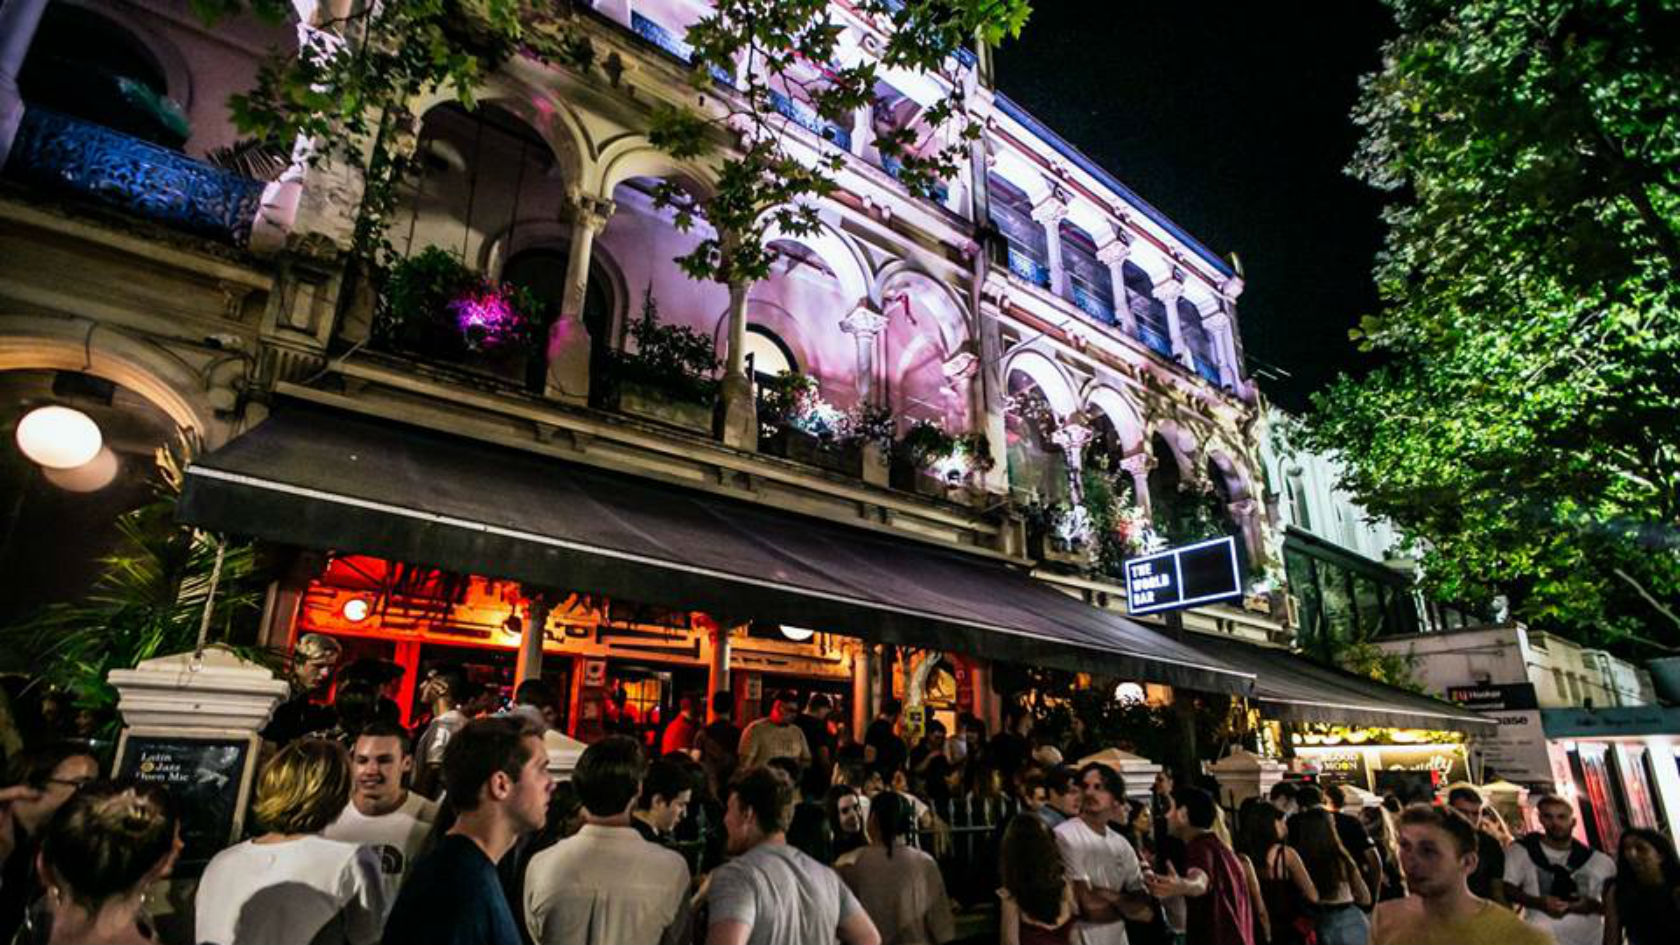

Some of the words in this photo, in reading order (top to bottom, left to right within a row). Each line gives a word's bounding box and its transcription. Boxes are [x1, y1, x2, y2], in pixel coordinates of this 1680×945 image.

[1130, 563, 1152, 577] THE
[1132, 574, 1170, 592] WORLD
[1133, 591, 1155, 606] BAR
[141, 751, 172, 762] Latin
[1323, 760, 1357, 770] MOON
[167, 771, 189, 781] Mic
